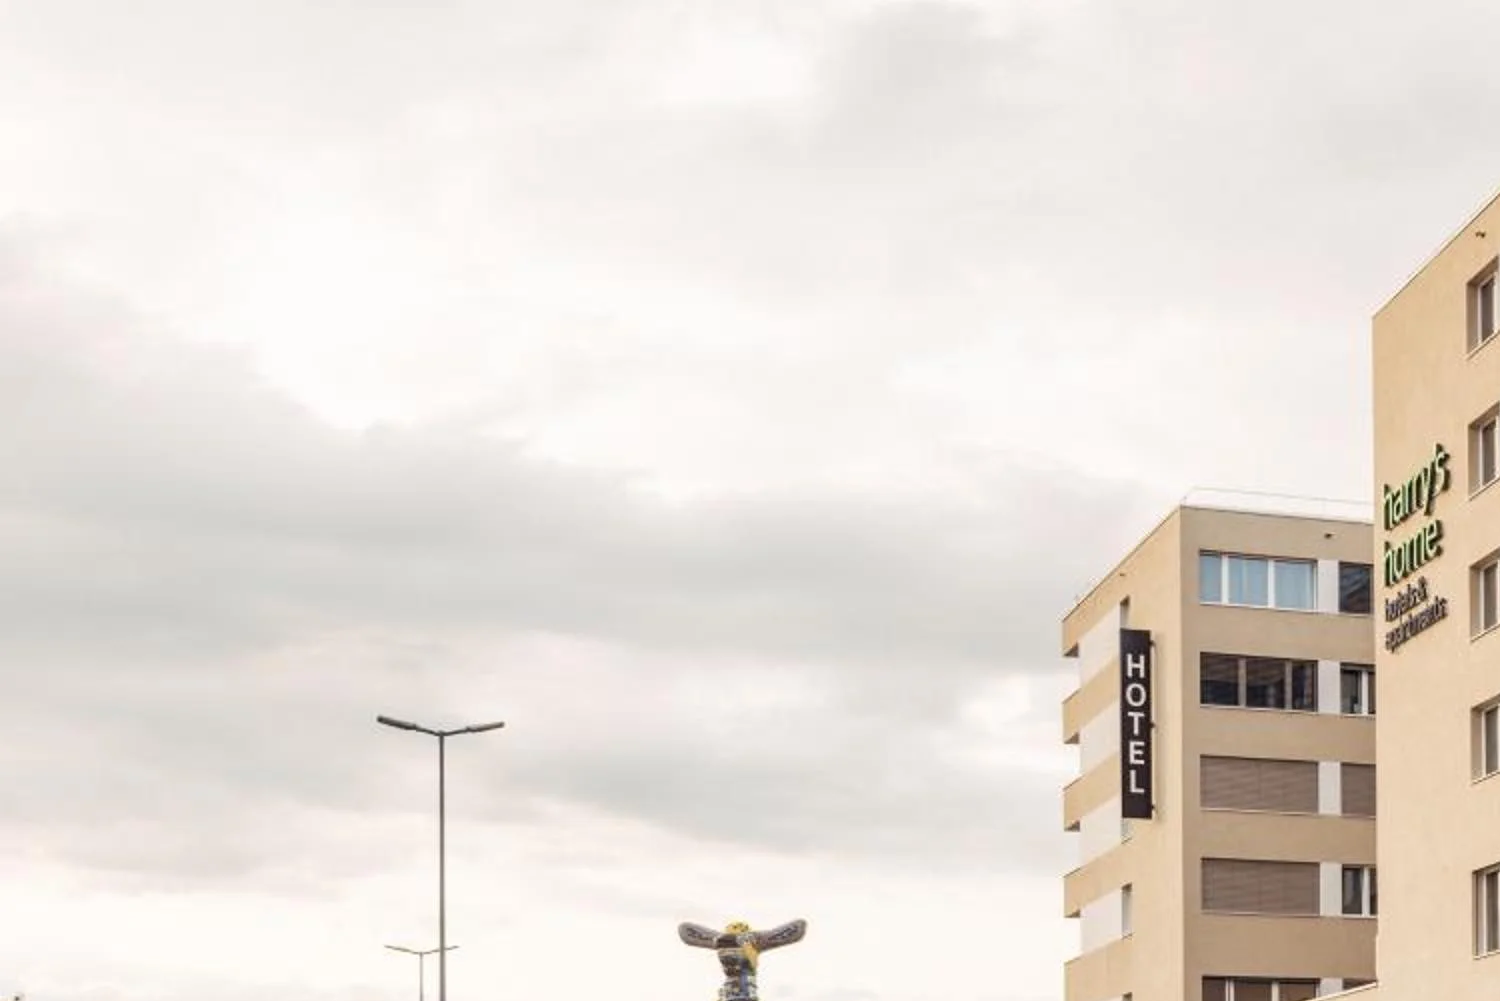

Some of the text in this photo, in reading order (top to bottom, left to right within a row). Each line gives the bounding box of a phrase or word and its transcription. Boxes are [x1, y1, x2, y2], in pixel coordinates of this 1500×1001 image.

[1384, 442, 1450, 531] harry's
[1384, 519, 1443, 587] home
[1125, 653, 1147, 794] HOTEL
